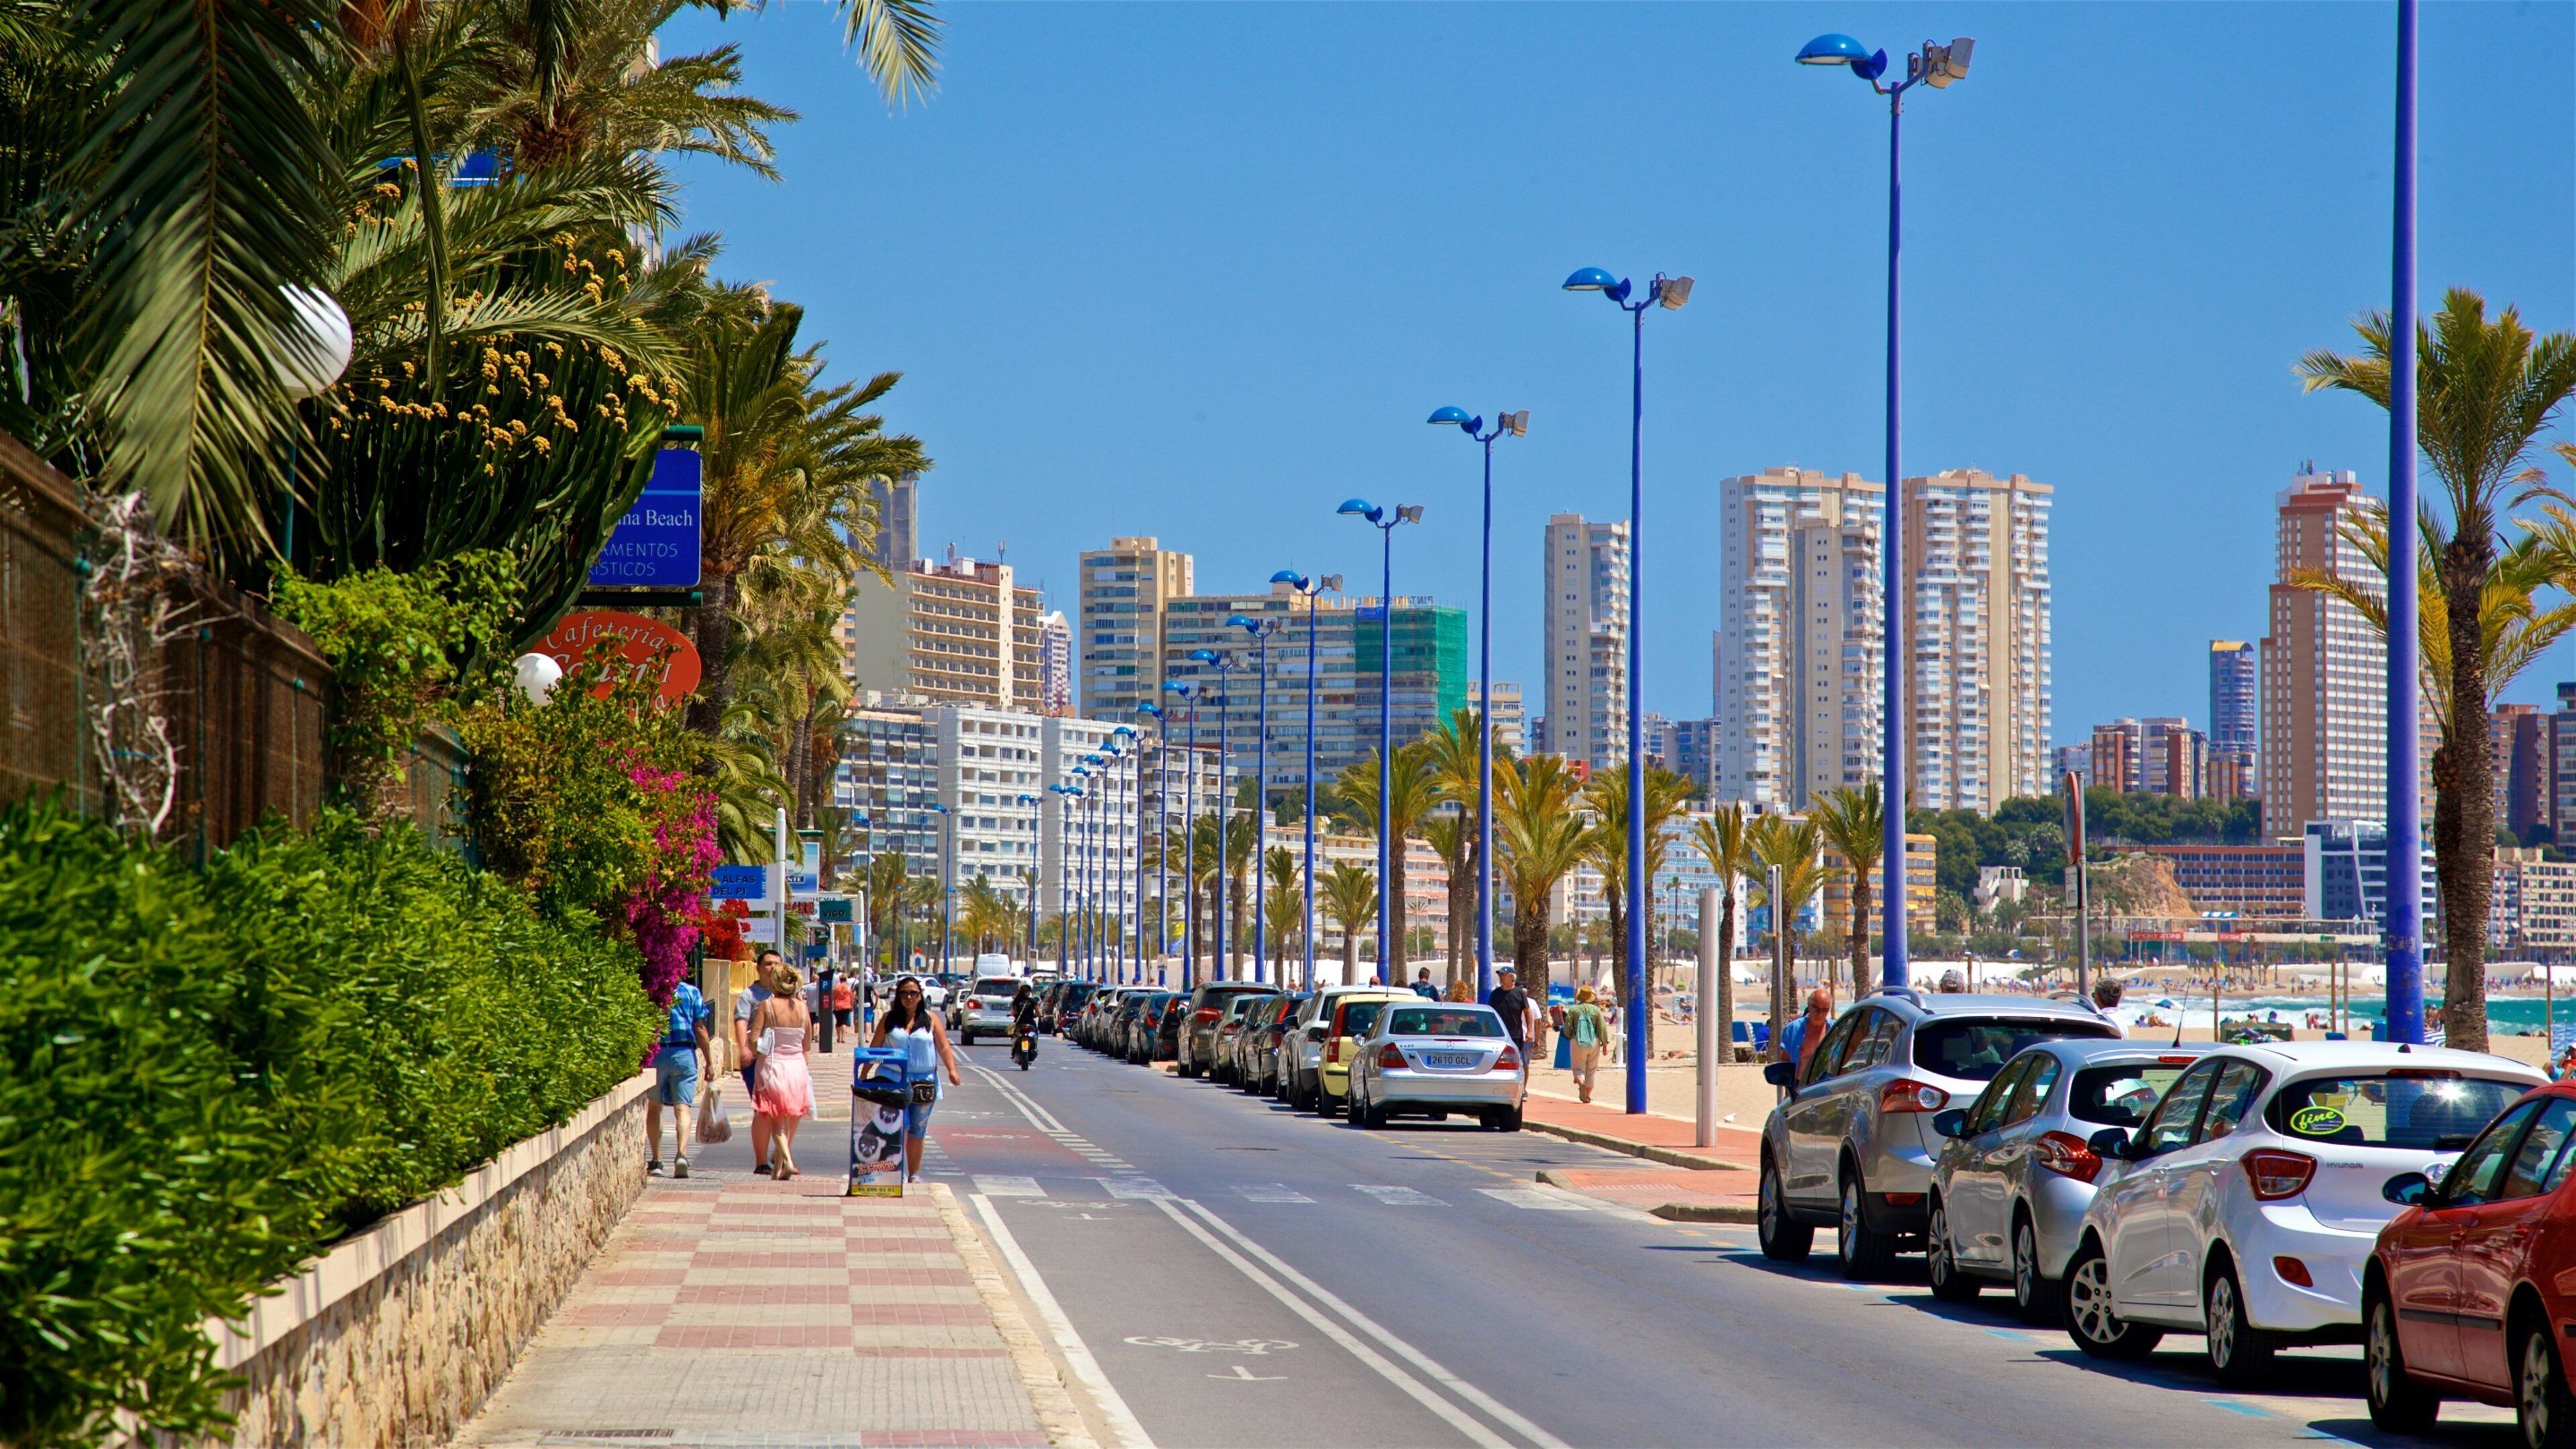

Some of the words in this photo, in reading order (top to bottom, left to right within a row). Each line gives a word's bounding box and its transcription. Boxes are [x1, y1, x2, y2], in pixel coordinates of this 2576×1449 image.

[646, 510, 692, 526] Beach
[714, 887, 733, 896] DEL
[736, 887, 747, 896] PI
[823, 909, 845, 918] VIGO
[822, 981, 828, 989] P
[1432, 1056, 1453, 1065] 2610
[1455, 1056, 1471, 1065] GCL
[2299, 1111, 2337, 1130] fine
